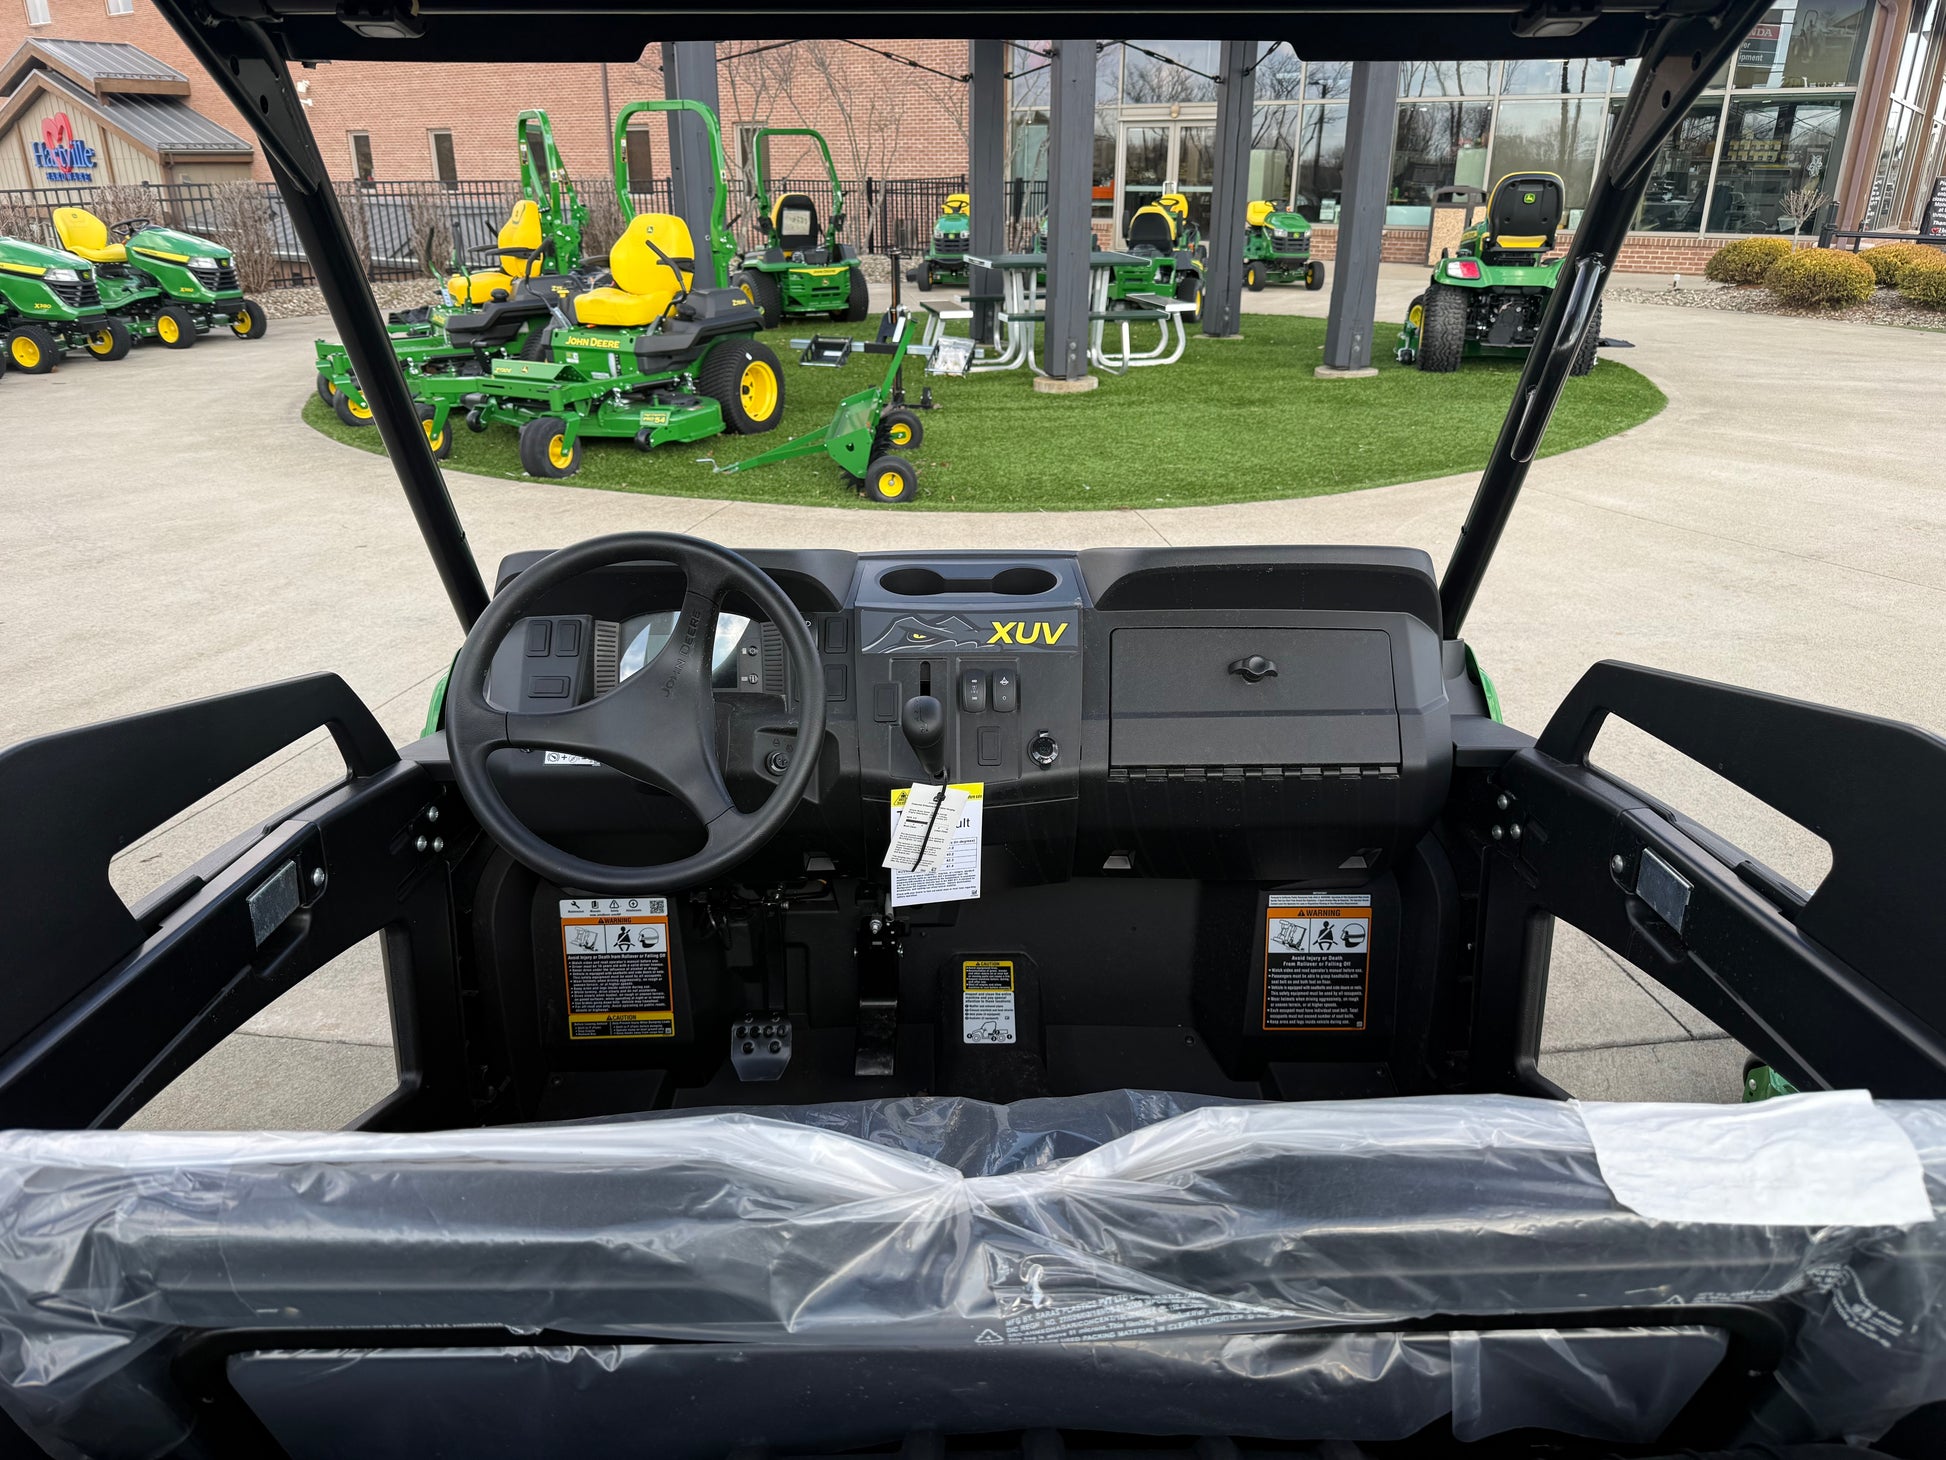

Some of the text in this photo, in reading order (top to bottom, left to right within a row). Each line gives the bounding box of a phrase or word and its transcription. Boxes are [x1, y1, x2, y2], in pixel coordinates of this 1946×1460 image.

[1751, 28, 1773, 37] NDA
[1739, 53, 1763, 62] ipment
[565, 336, 620, 349] JOHN DEERE
[986, 621, 1069, 645] XUV
[661, 609, 700, 698] JOHN DEERE
[1306, 909, 1341, 917] WARNING
